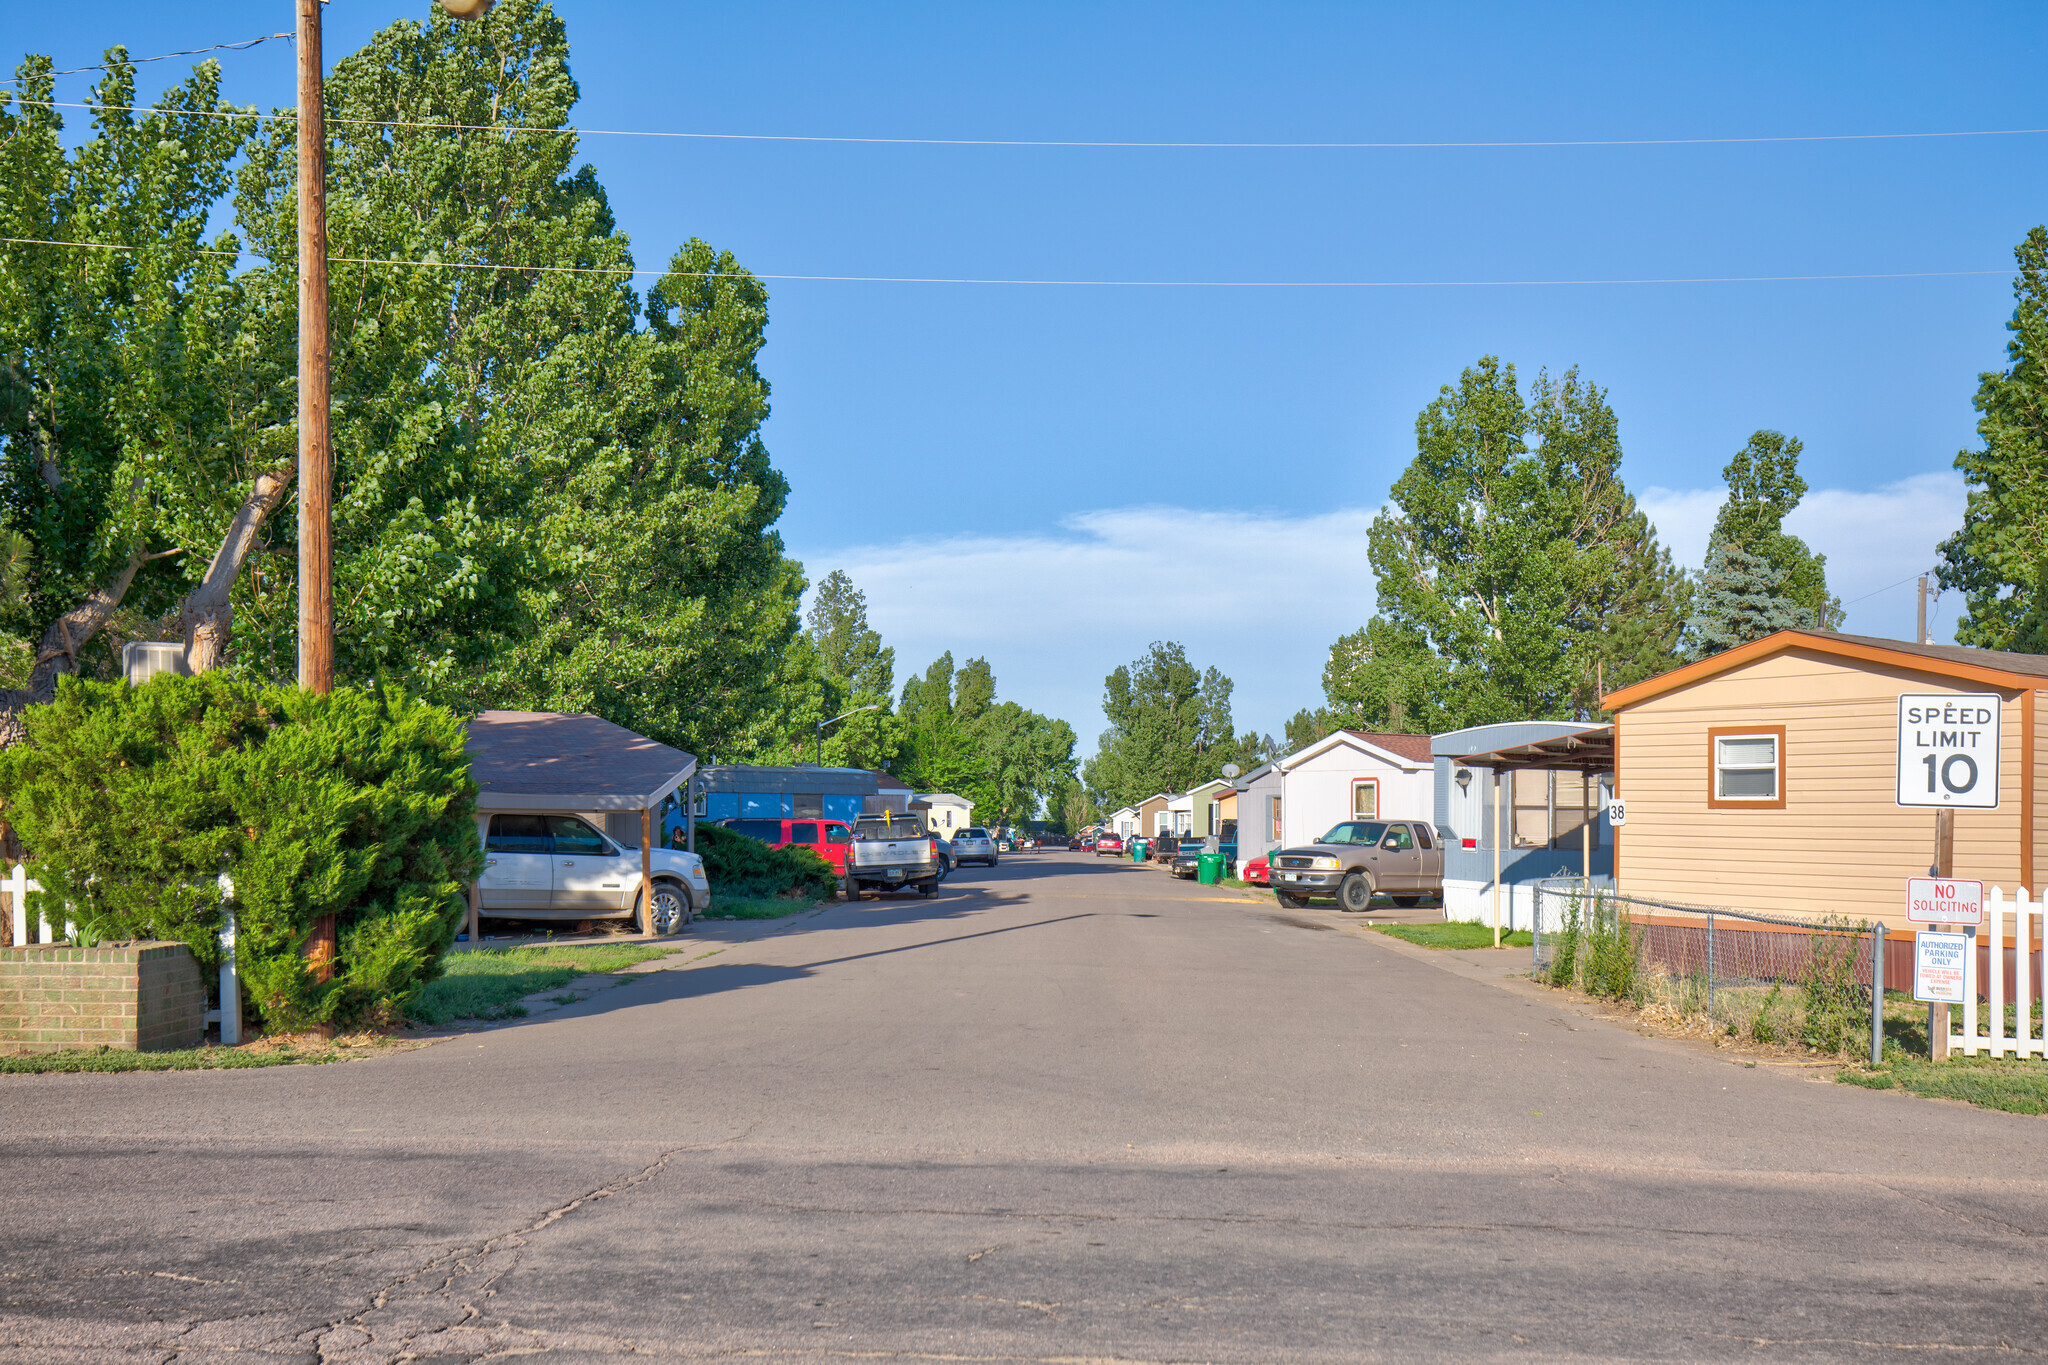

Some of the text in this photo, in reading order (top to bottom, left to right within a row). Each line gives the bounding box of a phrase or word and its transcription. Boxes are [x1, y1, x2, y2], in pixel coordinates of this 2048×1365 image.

[1908, 707, 1992, 725] SPEED
[1916, 730, 1981, 748] LIMIT
[1922, 753, 1978, 794] 10
[1611, 805, 1625, 820] 38
[860, 849, 926, 858] CHEVROLET
[1935, 884, 1955, 899] NO
[1913, 899, 1978, 913] SOLICITING
[1921, 940, 1963, 950] AUTHORIZED
[1924, 949, 1959, 958] PARKING
[1931, 957, 1951, 966] ONLY
